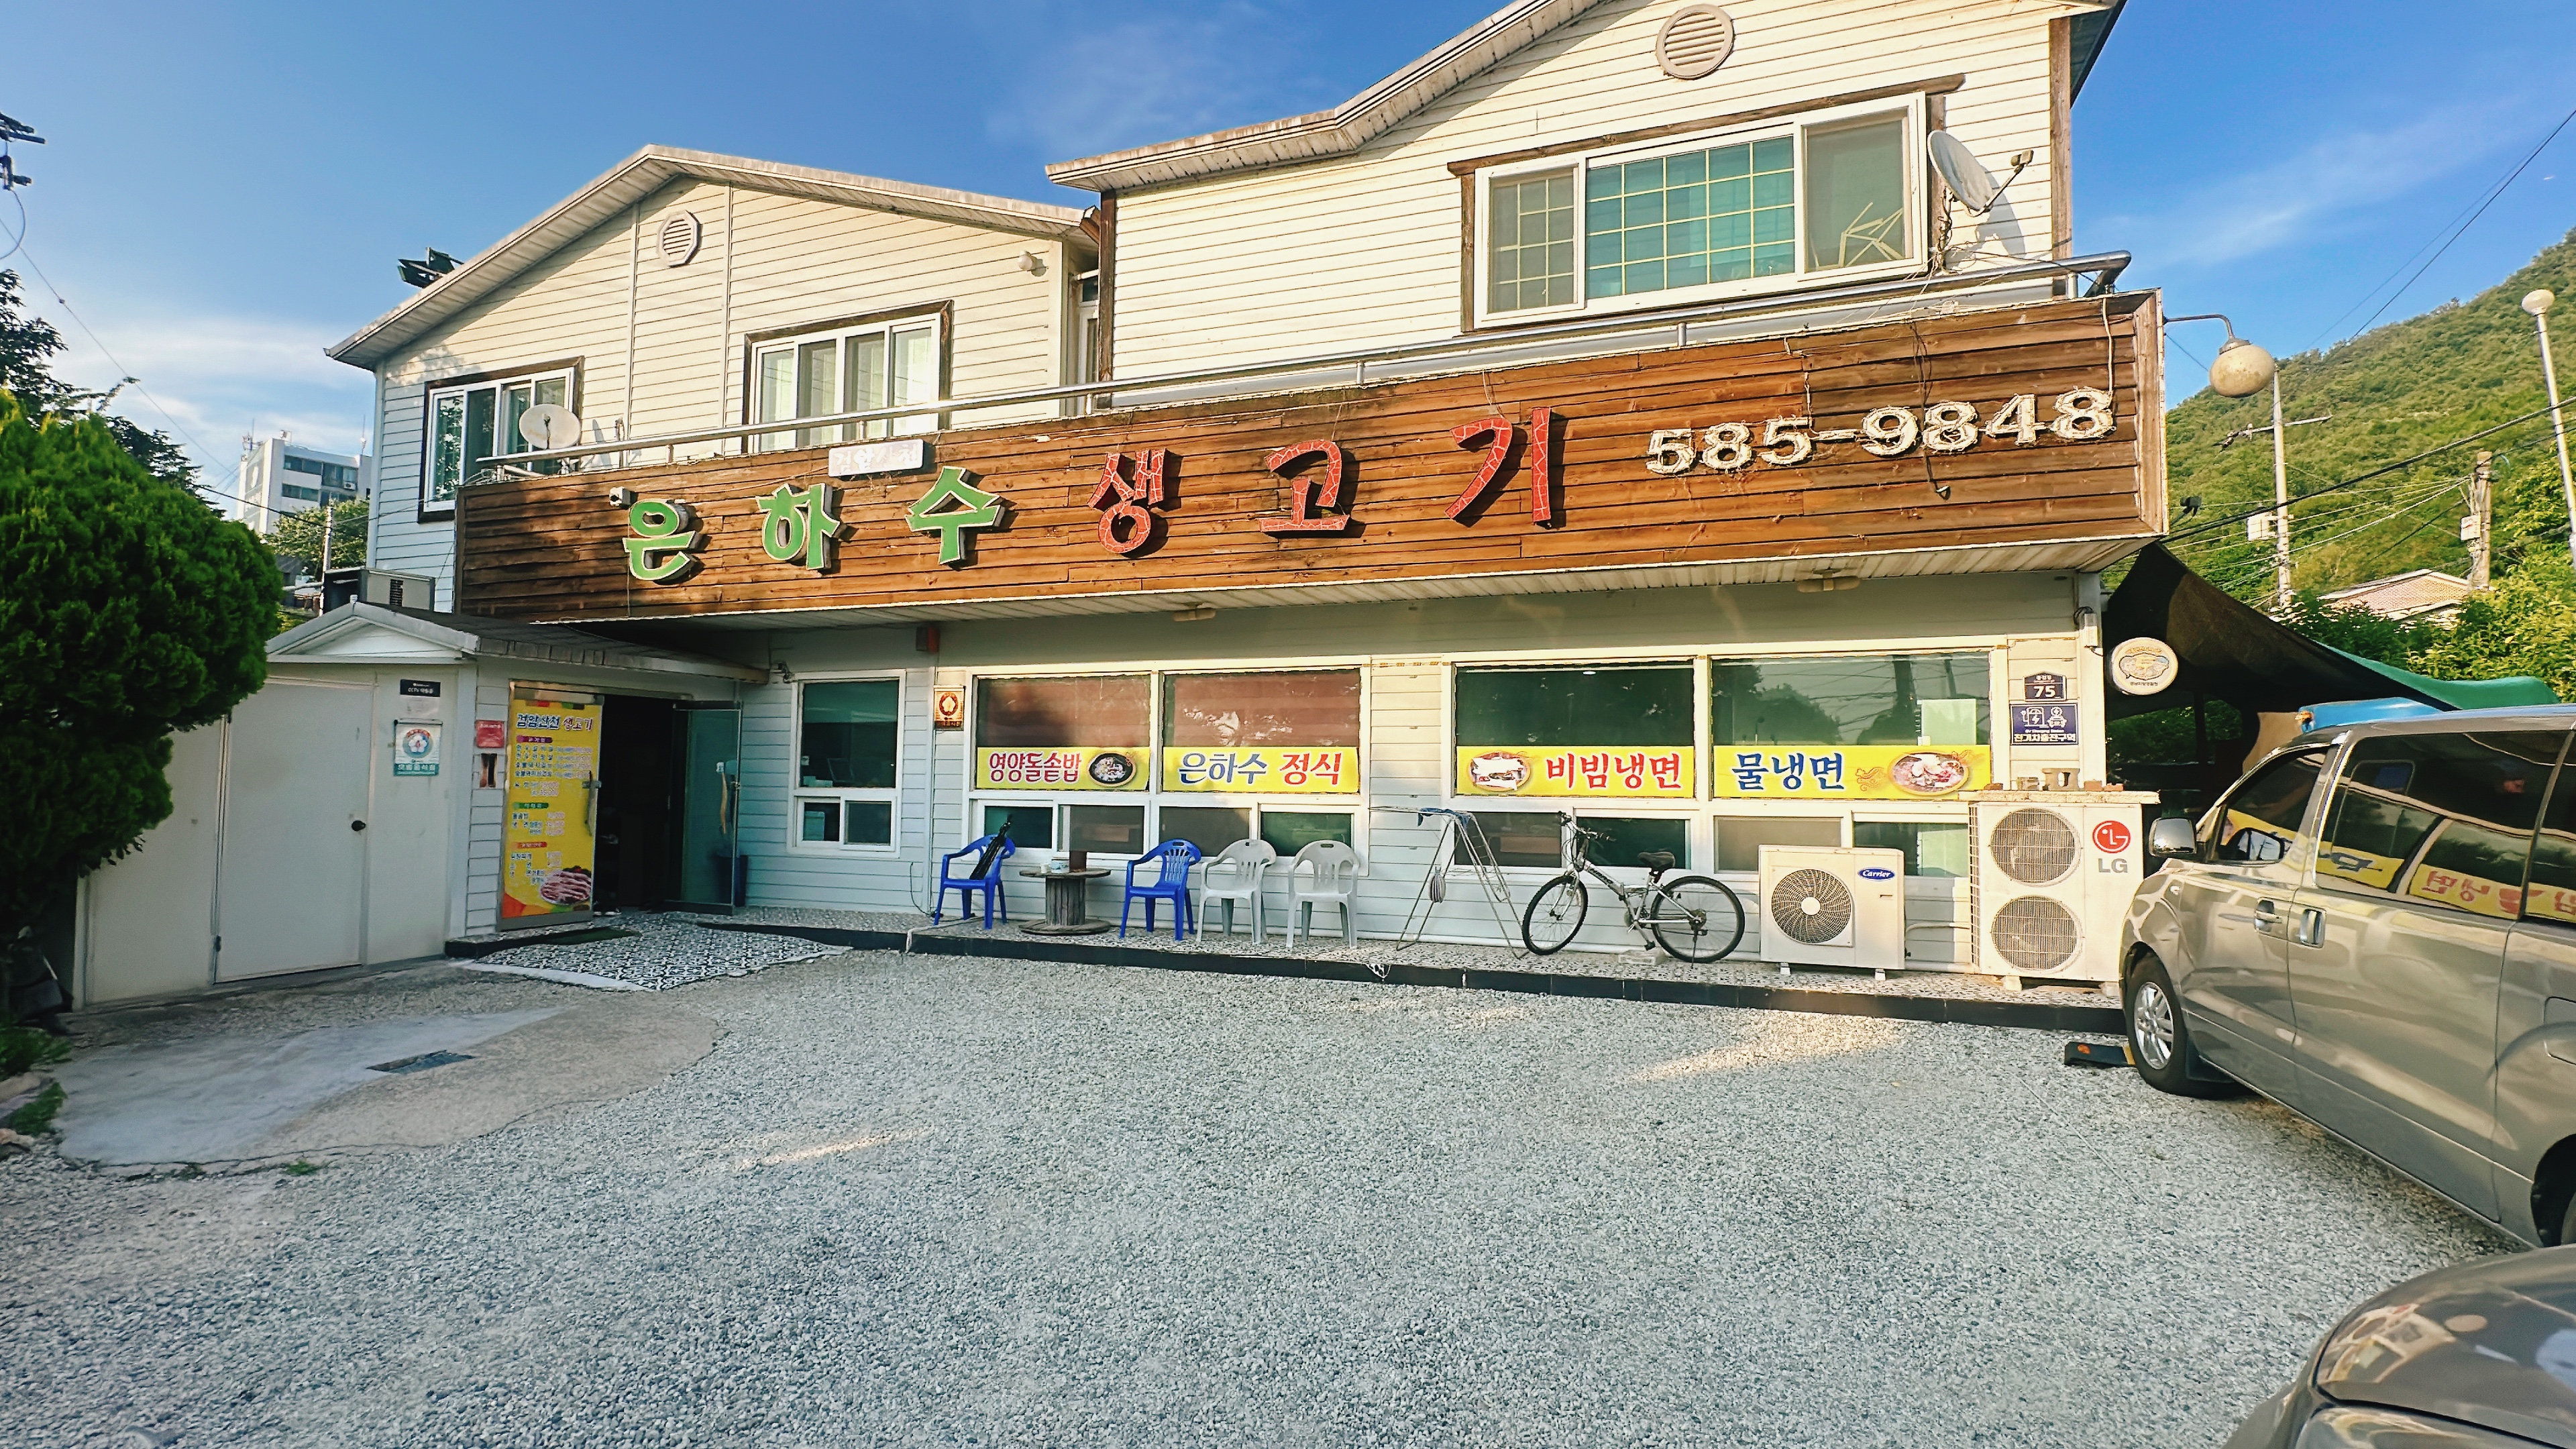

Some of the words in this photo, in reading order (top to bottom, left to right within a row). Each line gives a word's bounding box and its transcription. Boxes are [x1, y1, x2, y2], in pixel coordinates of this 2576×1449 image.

[1645, 386, 2116, 475] 585-9848
[622, 466, 1003, 582] 은하수
[1087, 406, 1551, 554] 생고기
[2033, 685, 2056, 698] 75
[517, 714, 561, 730] 검암산천
[563, 716, 593, 732] 생고기
[989, 752, 1082, 782] 영양돌솥밥
[1179, 753, 1267, 784] 은하수
[1279, 753, 1342, 785] 정식
[1546, 752, 1682, 789] 비빔냉면
[1731, 752, 1845, 790] 물냉면
[2094, 822, 2129, 853] LG
[1862, 869, 1891, 877] Carrier
[2098, 858, 2128, 873] LG
